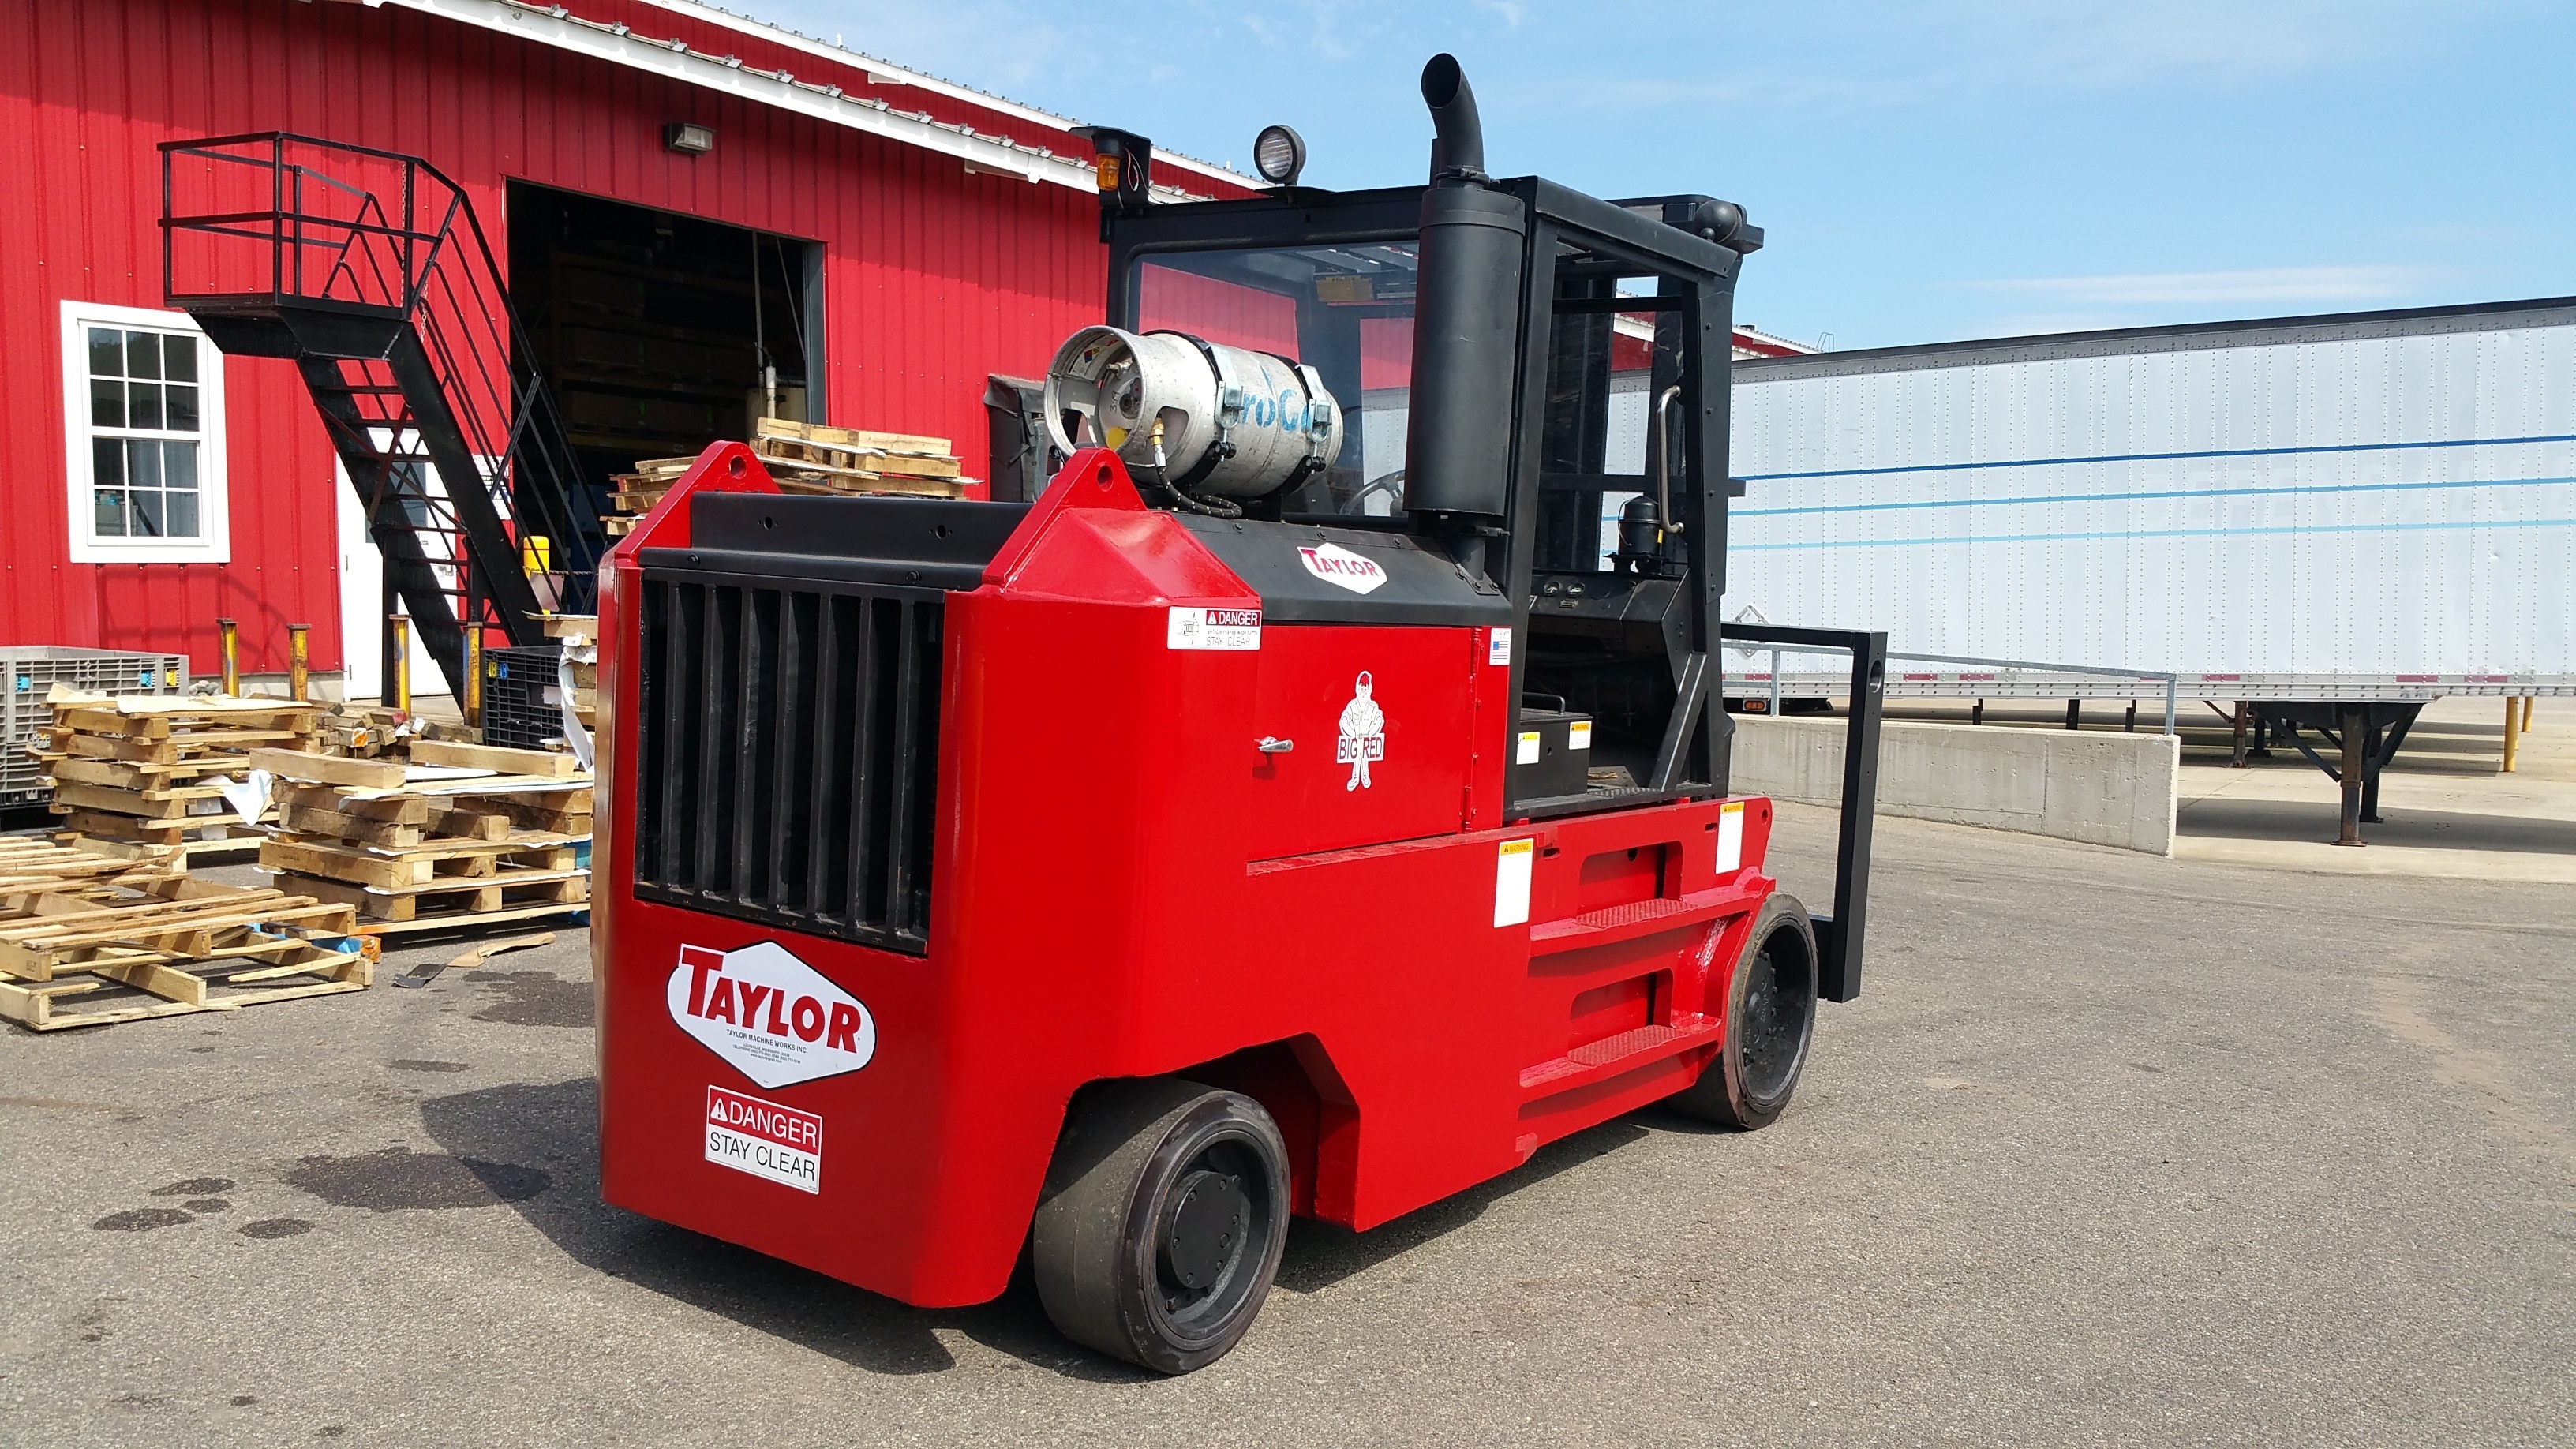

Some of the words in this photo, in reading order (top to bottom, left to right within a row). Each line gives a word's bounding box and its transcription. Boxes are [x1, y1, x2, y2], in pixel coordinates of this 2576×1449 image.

[1301, 549, 1380, 576] TAYLOR
[1218, 611, 1257, 625] DANGER
[1207, 636, 1223, 646] STAY
[1228, 637, 1250, 646] CLEAR
[1339, 738, 1357, 759] BIG
[1363, 736, 1382, 758] RED
[1509, 844, 1528, 853] WARNING
[681, 947, 862, 1054] TAYLOR
[727, 1029, 747, 1040] TAYLOR
[748, 1034, 773, 1046] MACHINE
[774, 1040, 796, 1050] WORKS
[729, 1099, 817, 1148] DANGER
[710, 1131, 751, 1160] STAY
[756, 1145, 815, 1181] CLEAR
